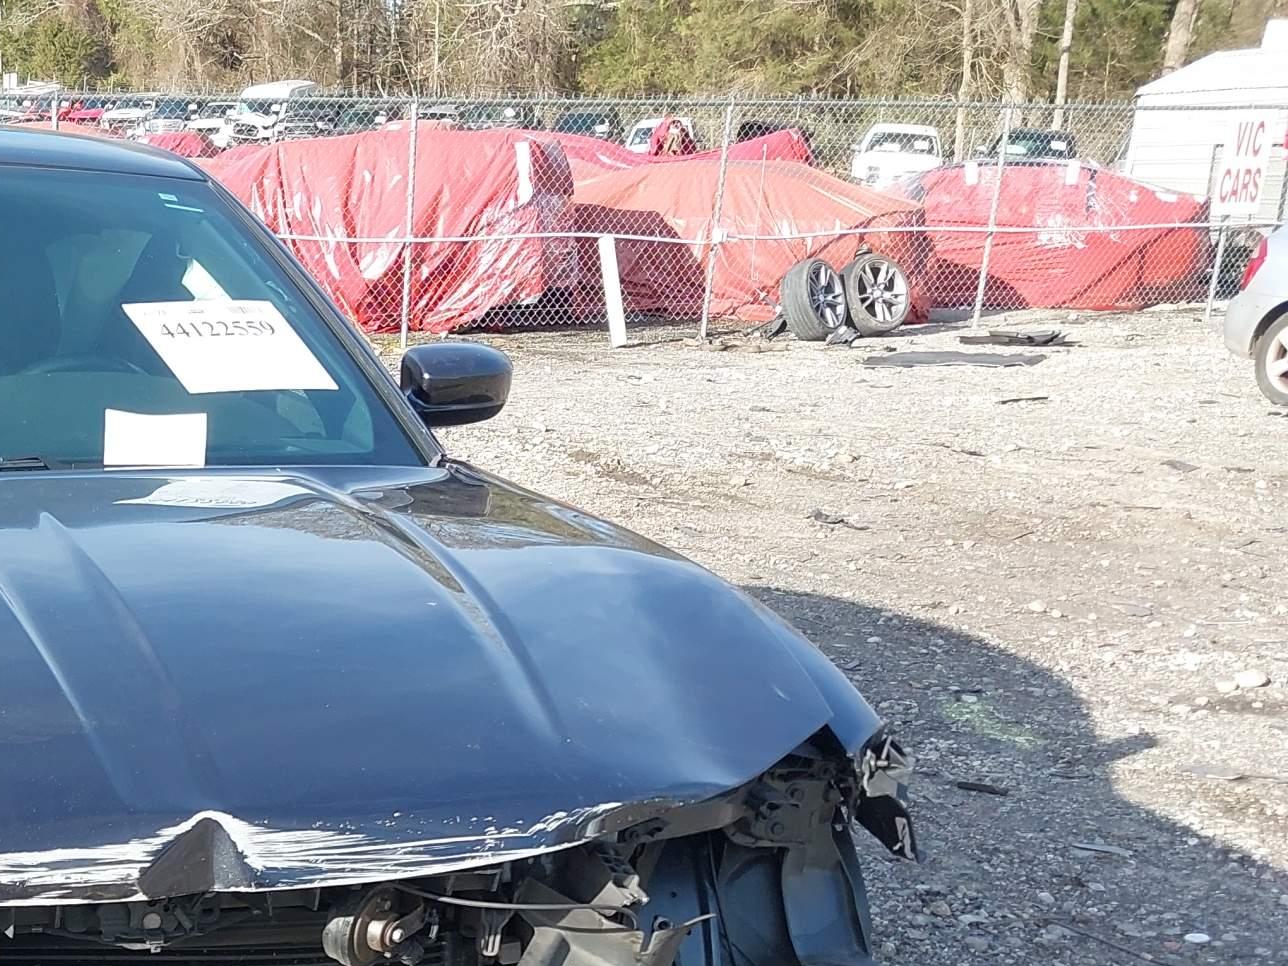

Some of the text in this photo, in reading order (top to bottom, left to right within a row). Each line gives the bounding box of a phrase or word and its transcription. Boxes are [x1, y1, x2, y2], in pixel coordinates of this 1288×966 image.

[1236, 121, 1265, 157] VIC
[1219, 168, 1261, 203] CARS
[161, 320, 275, 338] 44122559
